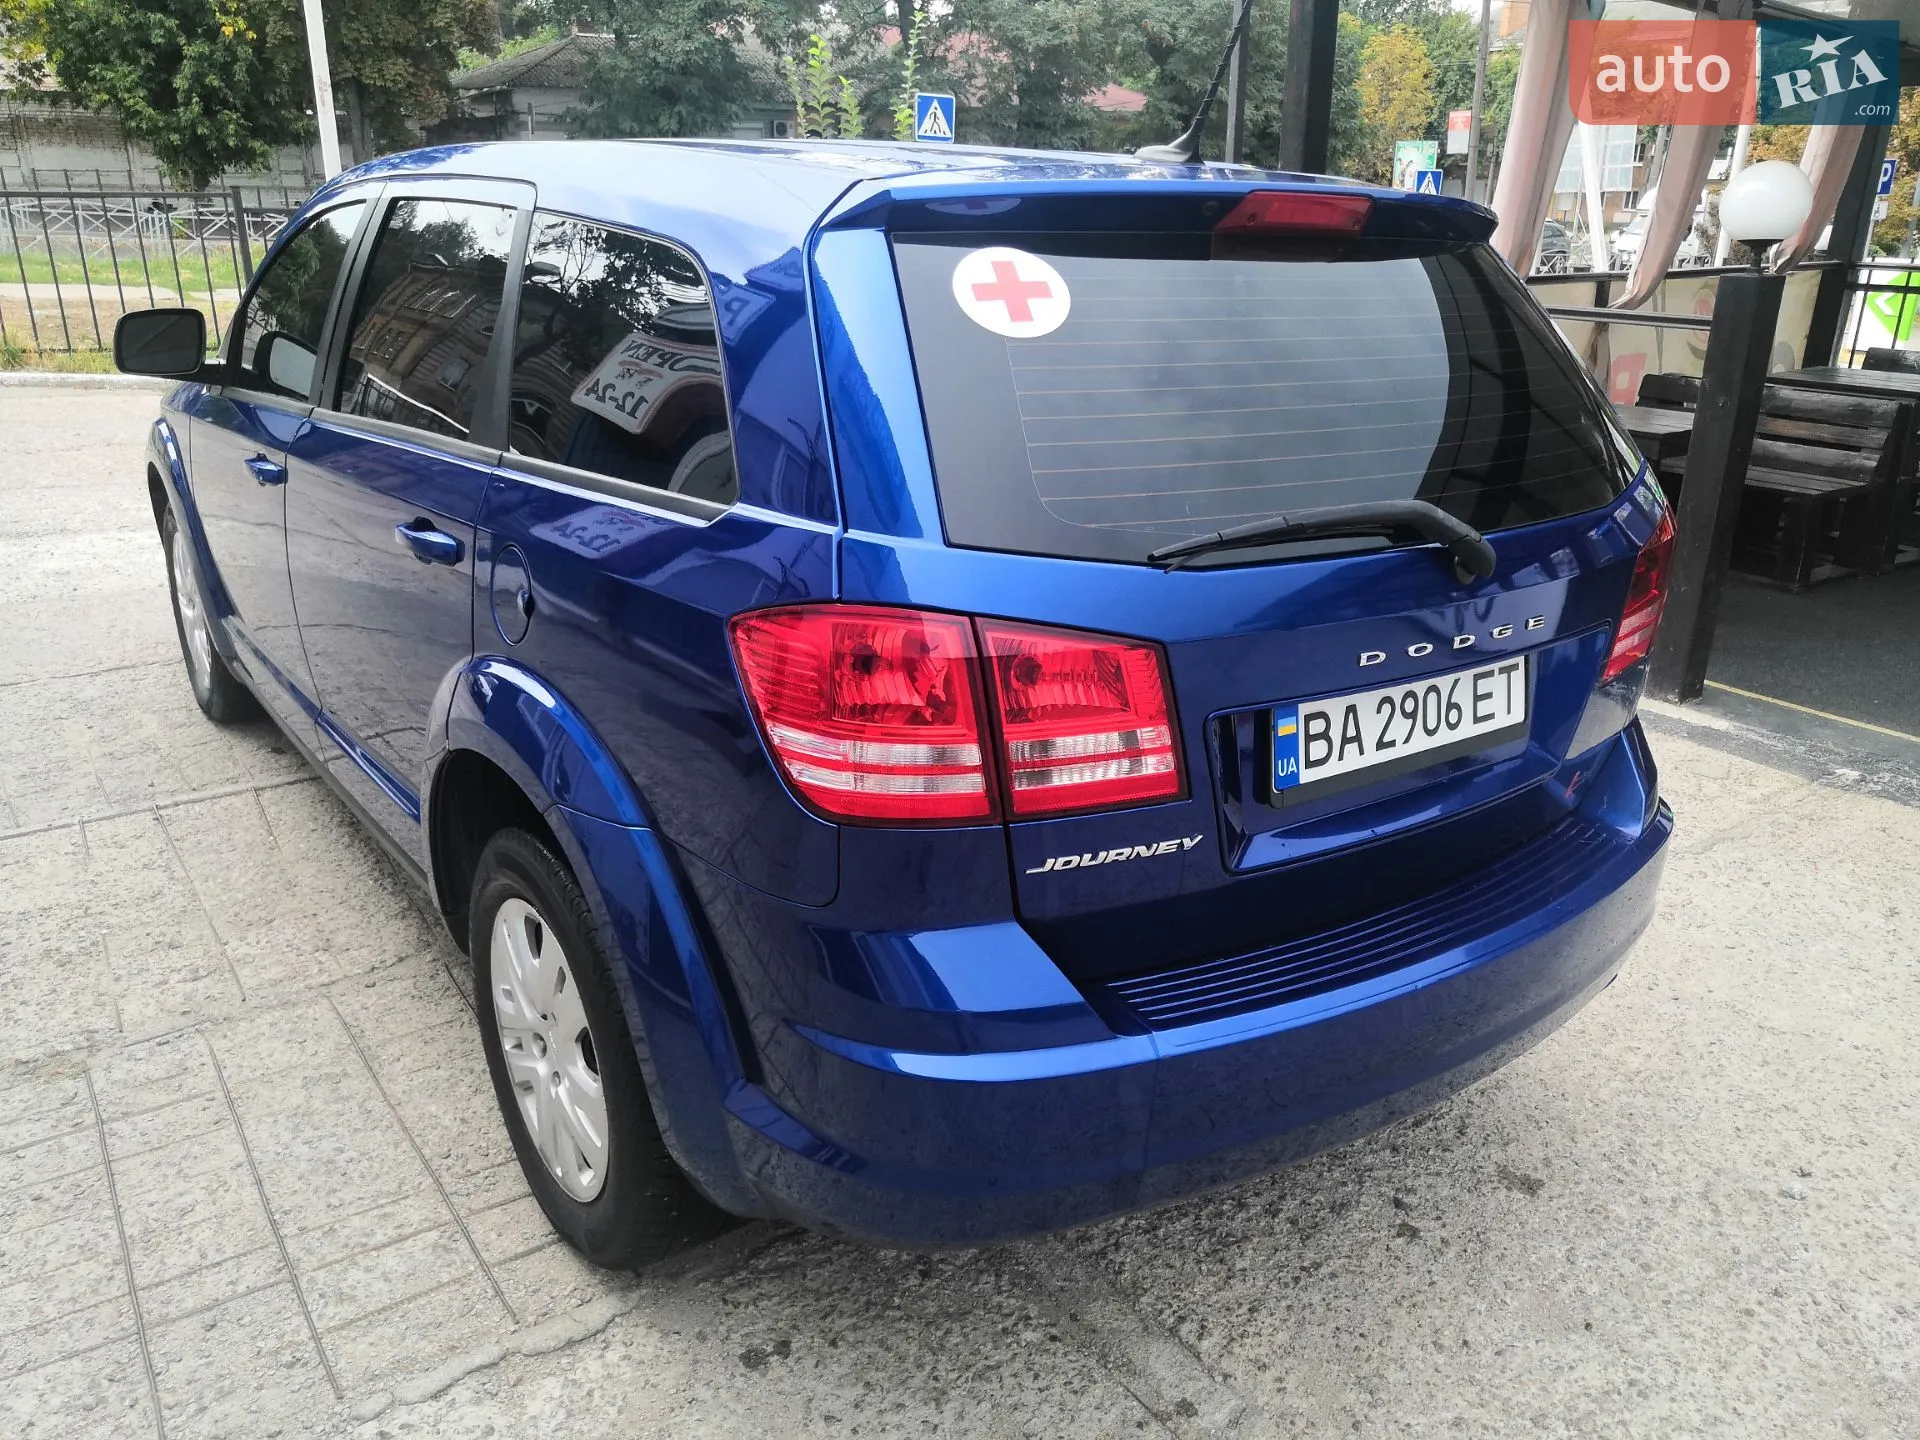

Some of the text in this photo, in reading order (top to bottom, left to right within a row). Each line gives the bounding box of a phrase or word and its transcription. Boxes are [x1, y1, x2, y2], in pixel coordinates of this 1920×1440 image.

[1877, 162, 1892, 193] P
[1359, 615, 1546, 667] DODGE
[1303, 663, 1520, 770] BA 2906 ET
[1278, 756, 1298, 777] UA
[1025, 834, 1203, 874] JOURNEY
